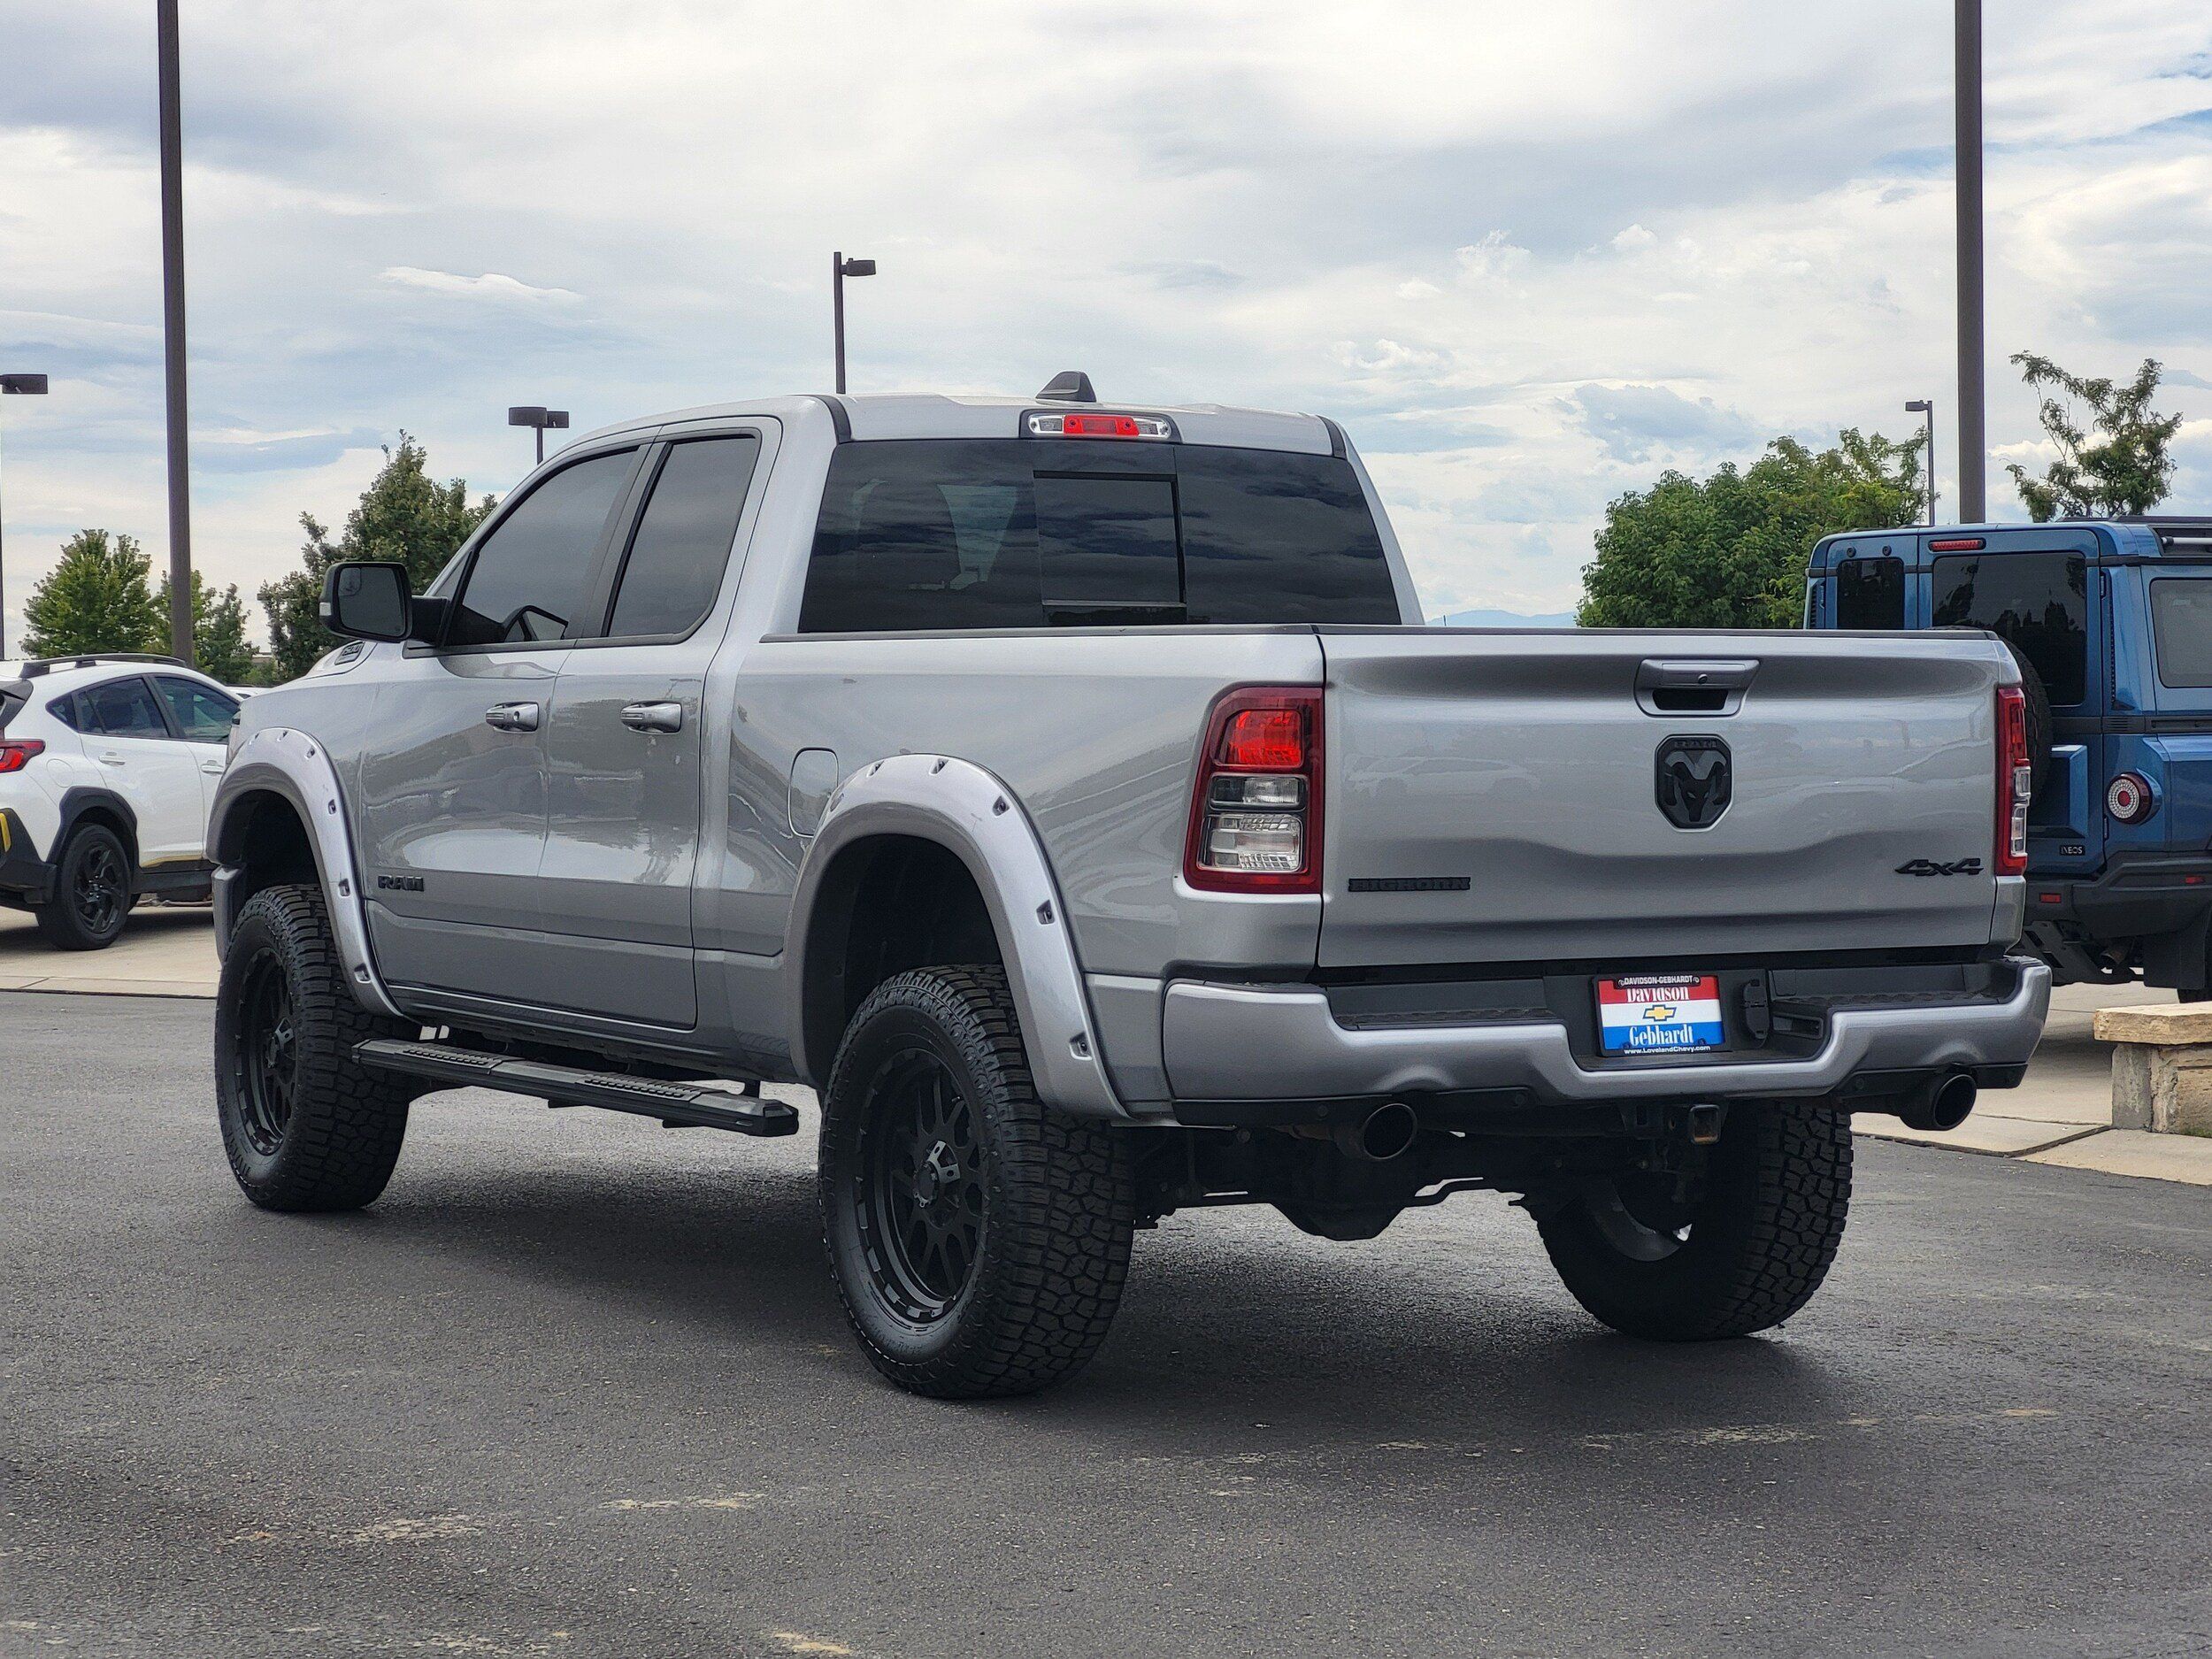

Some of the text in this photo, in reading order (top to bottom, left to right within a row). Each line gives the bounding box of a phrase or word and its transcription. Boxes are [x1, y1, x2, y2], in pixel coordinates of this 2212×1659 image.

[1894, 858, 1984, 876] 4x4
[378, 875, 425, 892] RAM
[1624, 975, 1694, 986] DAVIDSON-GEBHARDT
[1626, 987, 1690, 1002] Davidson
[1629, 1024, 1694, 1046] Gebhardt
[1624, 1045, 1711, 1055] www.LovelandChevy.com
